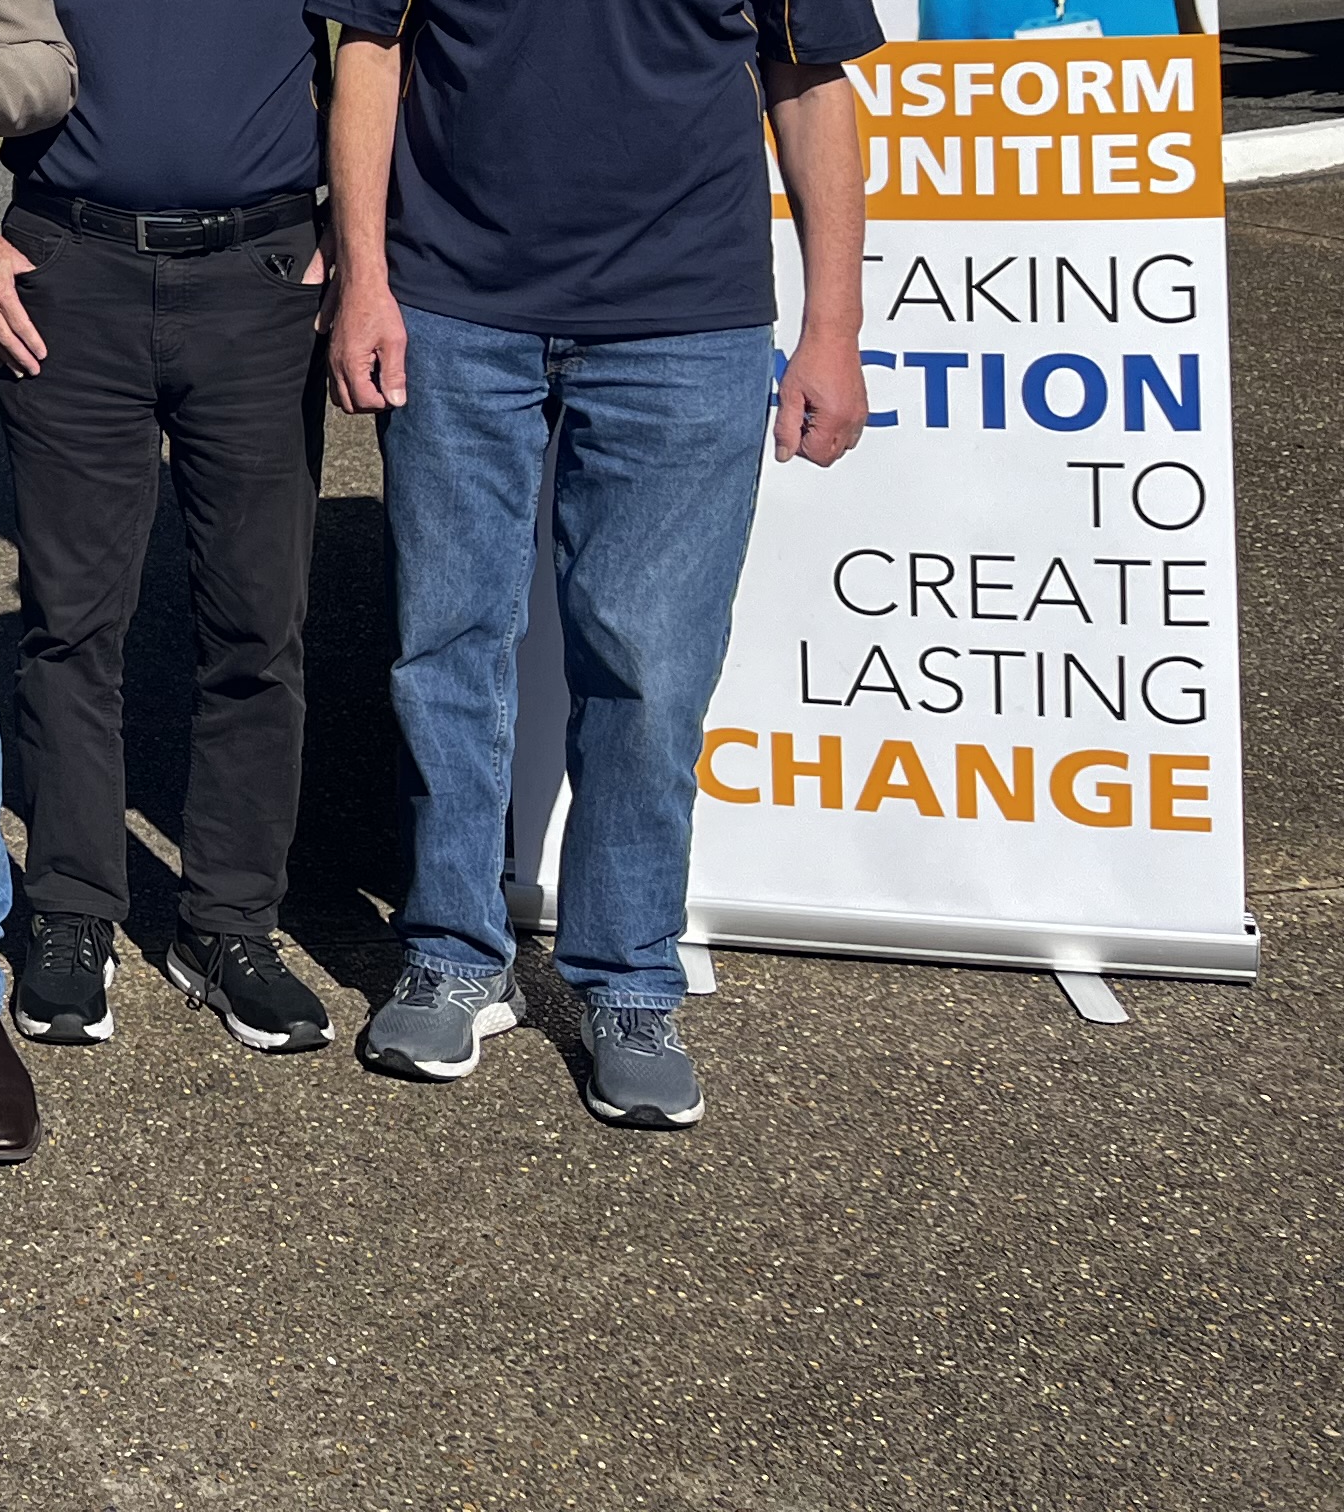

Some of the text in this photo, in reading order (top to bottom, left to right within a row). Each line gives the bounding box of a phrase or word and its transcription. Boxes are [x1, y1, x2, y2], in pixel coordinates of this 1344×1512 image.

[842, 57, 1195, 117] NSFORM
[864, 253, 1197, 325] AKING
[864, 349, 1202, 433] CTION
[1066, 461, 1206, 531] TO
[833, 549, 1210, 627] CREATE
[800, 640, 1207, 725] LASTING
[696, 727, 1212, 833] CHANGE
